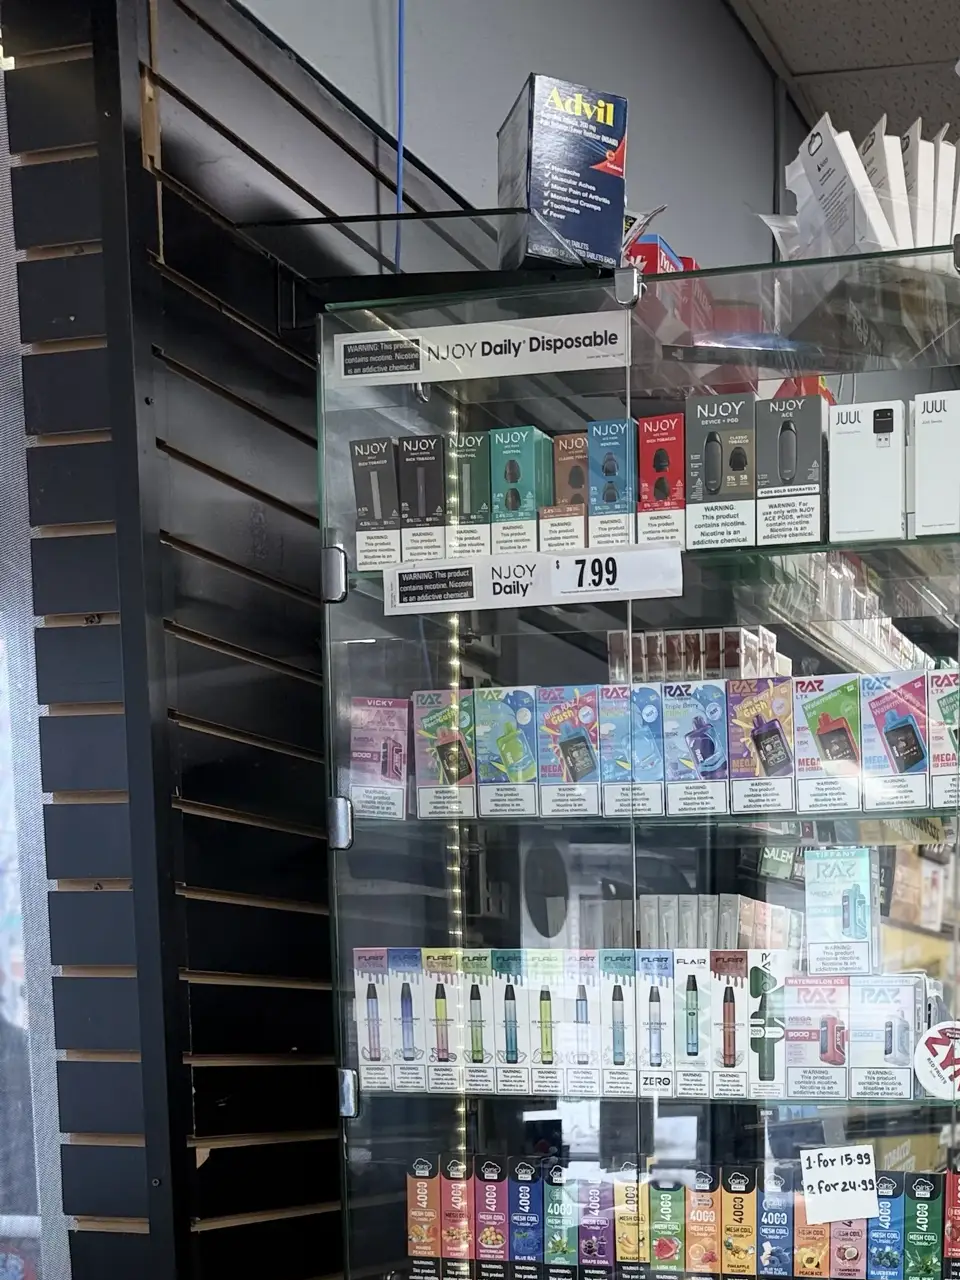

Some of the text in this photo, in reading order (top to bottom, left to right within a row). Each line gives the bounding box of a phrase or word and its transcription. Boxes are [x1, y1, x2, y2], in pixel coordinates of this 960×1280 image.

[545, 86, 614, 127] Advil
[428, 342, 478, 361] NJOY
[529, 330, 618, 352] Disposable
[921, 400, 947, 414] JUUL
[836, 410, 862, 425] JUUL
[354, 442, 388, 456] NJOY
[403, 439, 437, 452] NJOY
[491, 564, 536, 580] NJOY
[574, 556, 618, 588] 7.99
[492, 581, 532, 597] Daily
[796, 680, 824, 692] RAZ
[367, 699, 394, 707] VICKY
[763, 847, 793, 864] SALEM
[676, 957, 707, 965] FLAIR
[642, 1075, 671, 1086] ZERO
[840, 1152, 872, 1166] 15.99
[807, 1183, 815, 1195] 2
[841, 1178, 876, 1193] 24.99
